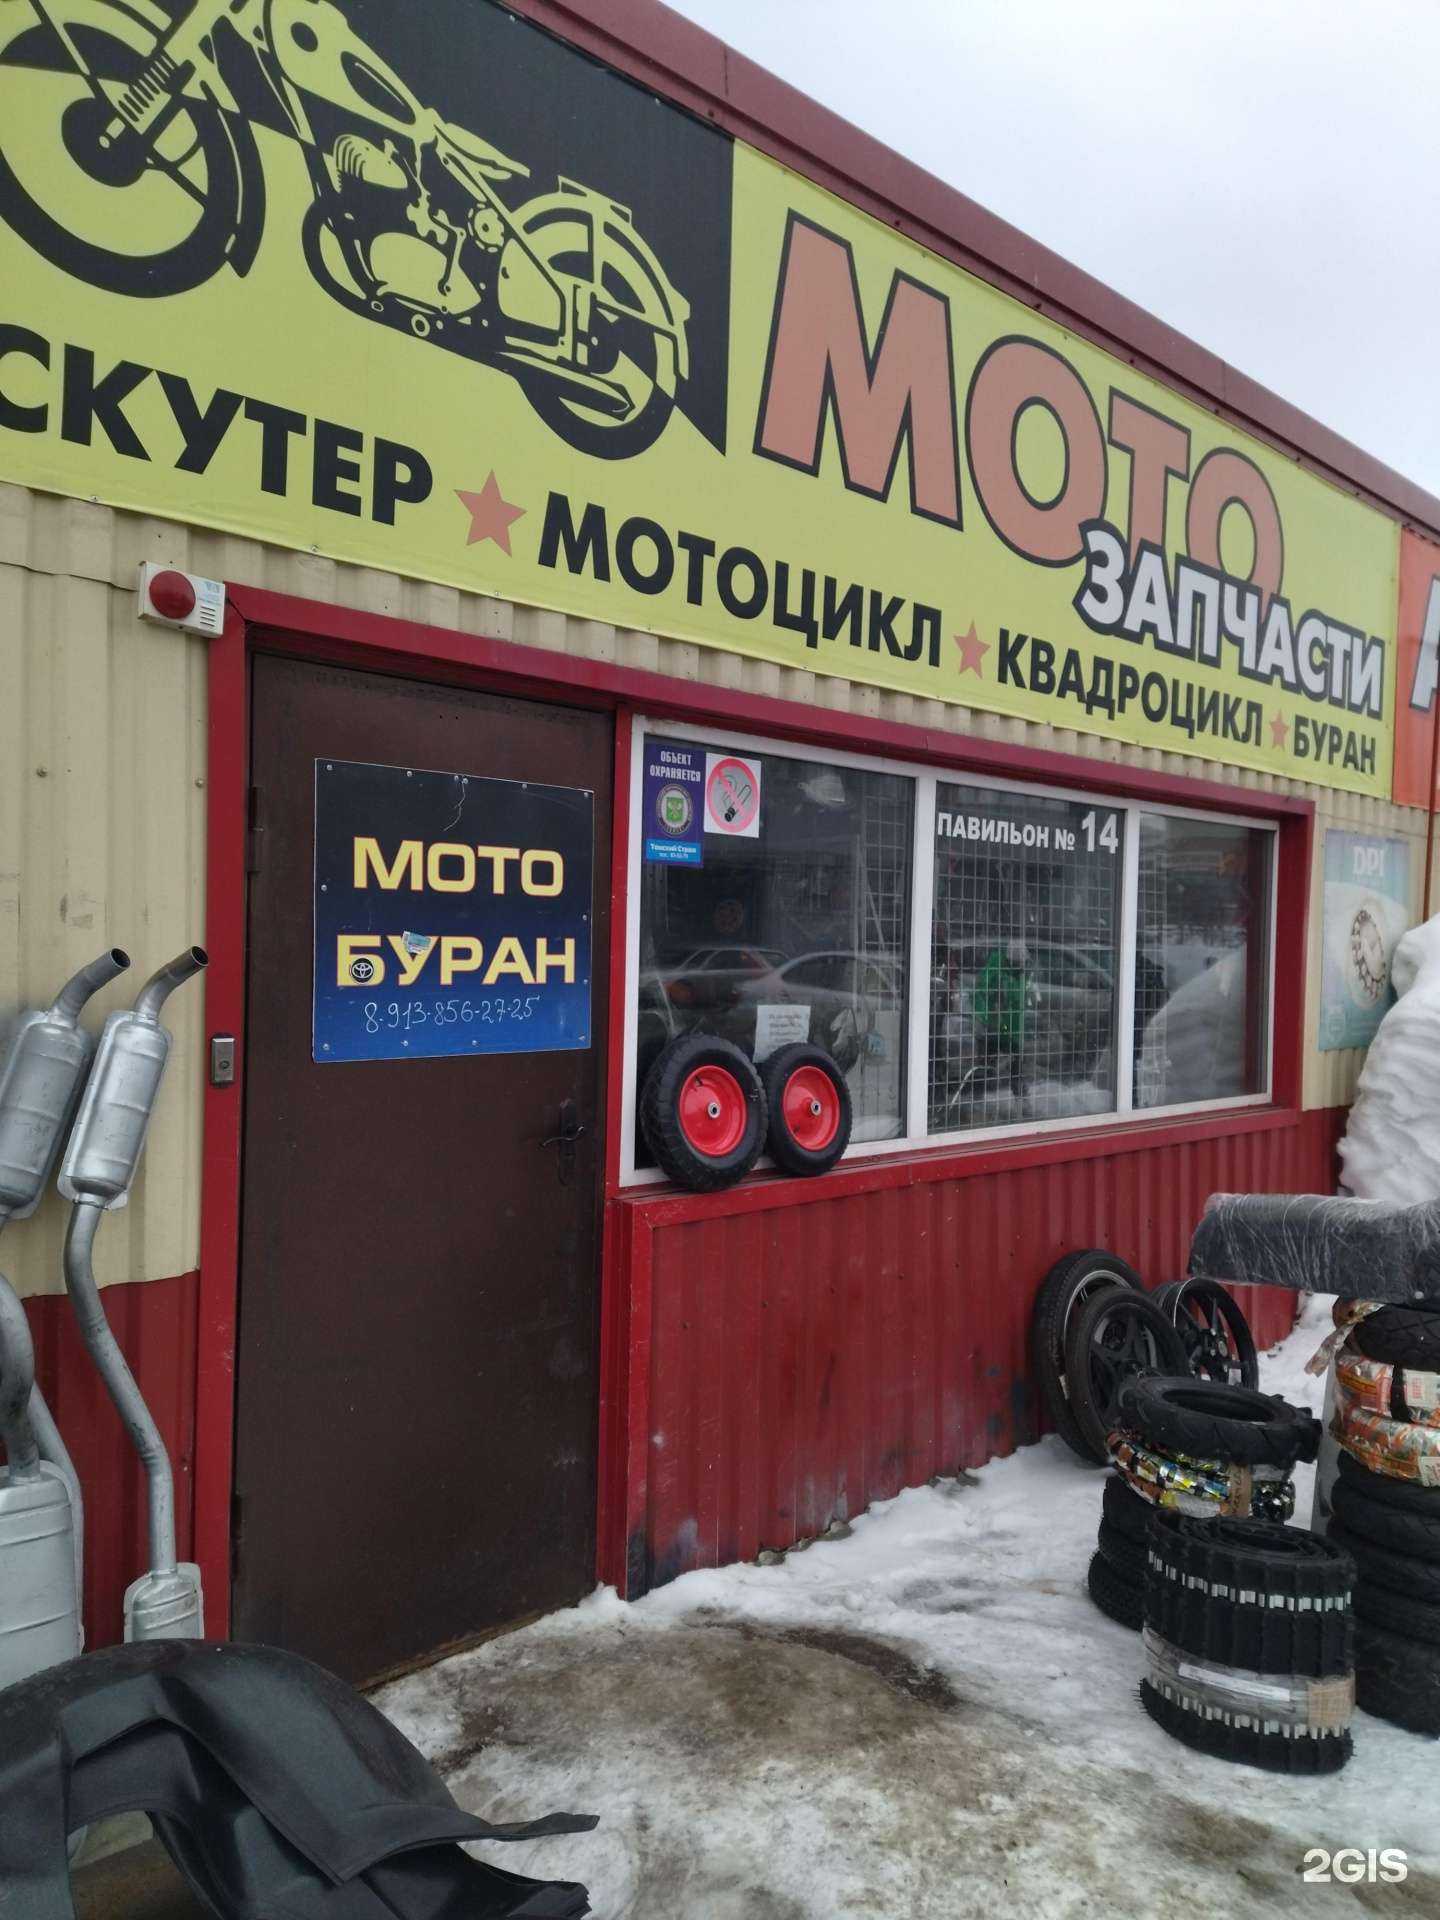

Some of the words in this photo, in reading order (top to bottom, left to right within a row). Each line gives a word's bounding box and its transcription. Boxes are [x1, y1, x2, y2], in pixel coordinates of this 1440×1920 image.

[0, 322, 434, 528] СКУТЕР
[752, 206, 1284, 602] МОТО
[538, 490, 943, 669] МОТОЦИКЛ
[1072, 517, 1386, 722] ЗАПЧАСТИ
[996, 628, 1264, 748] КВАДРОЦИКЛ
[649, 764, 701, 783] ОХРАНЯЕТСЯ
[660, 750, 693, 766] ОБЪЕКТ
[1293, 715, 1378, 777] БУРАН
[937, 812, 1050, 849] ПАВИЛЬОН
[1054, 827, 1077, 851] №
[1081, 810, 1120, 855] 14
[352, 835, 565, 897] МОТО
[336, 933, 577, 988] БУРАН
